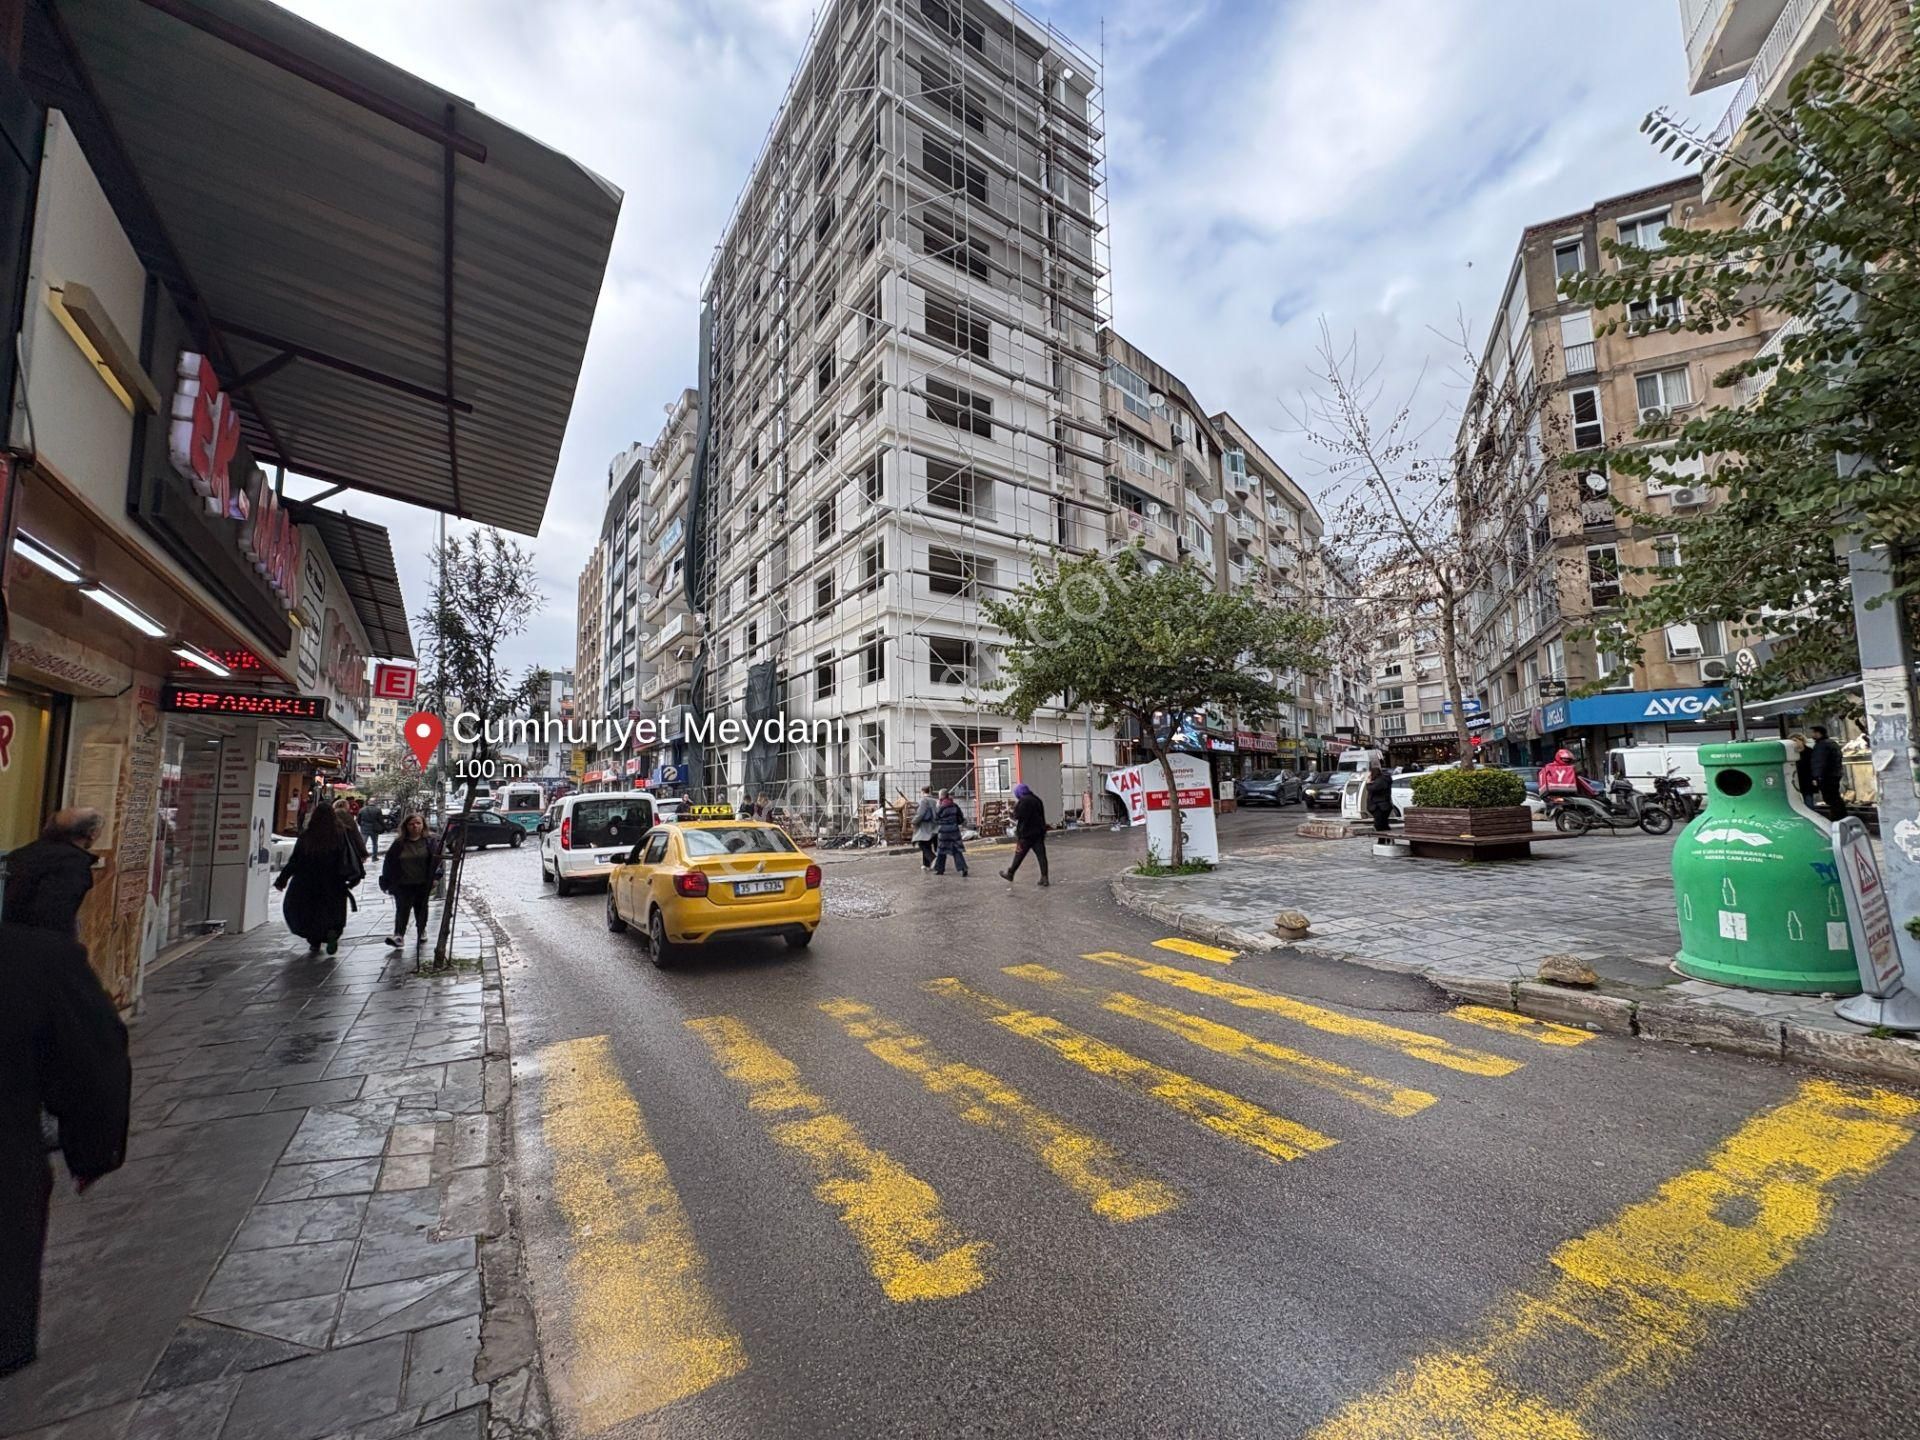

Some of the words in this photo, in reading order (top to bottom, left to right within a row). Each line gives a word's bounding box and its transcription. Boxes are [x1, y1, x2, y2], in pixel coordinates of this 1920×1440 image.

[386, 671, 407, 693] E
[1643, 695, 1721, 716] AYGA
[1162, 798, 1196, 807] KUARASI
